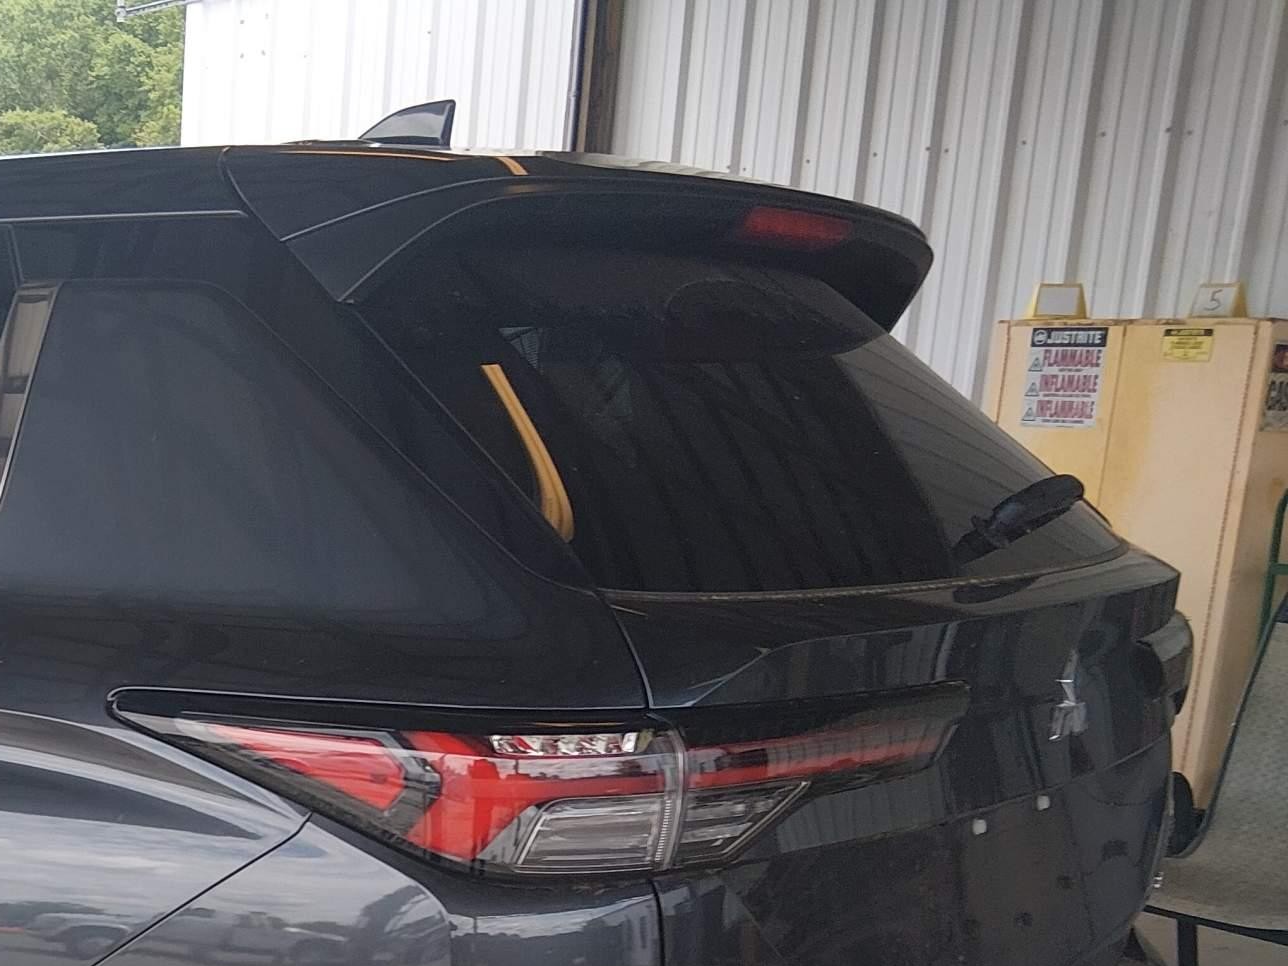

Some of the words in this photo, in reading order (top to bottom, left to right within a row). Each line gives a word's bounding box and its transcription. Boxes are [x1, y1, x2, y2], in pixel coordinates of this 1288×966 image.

[1204, 289, 1223, 311] 5
[1048, 331, 1104, 344] JUSTRITE
[1043, 349, 1101, 367] FLAMMABLE
[1038, 374, 1099, 393] INFLAMABLE
[1035, 400, 1096, 419] INFLAMMABLE
